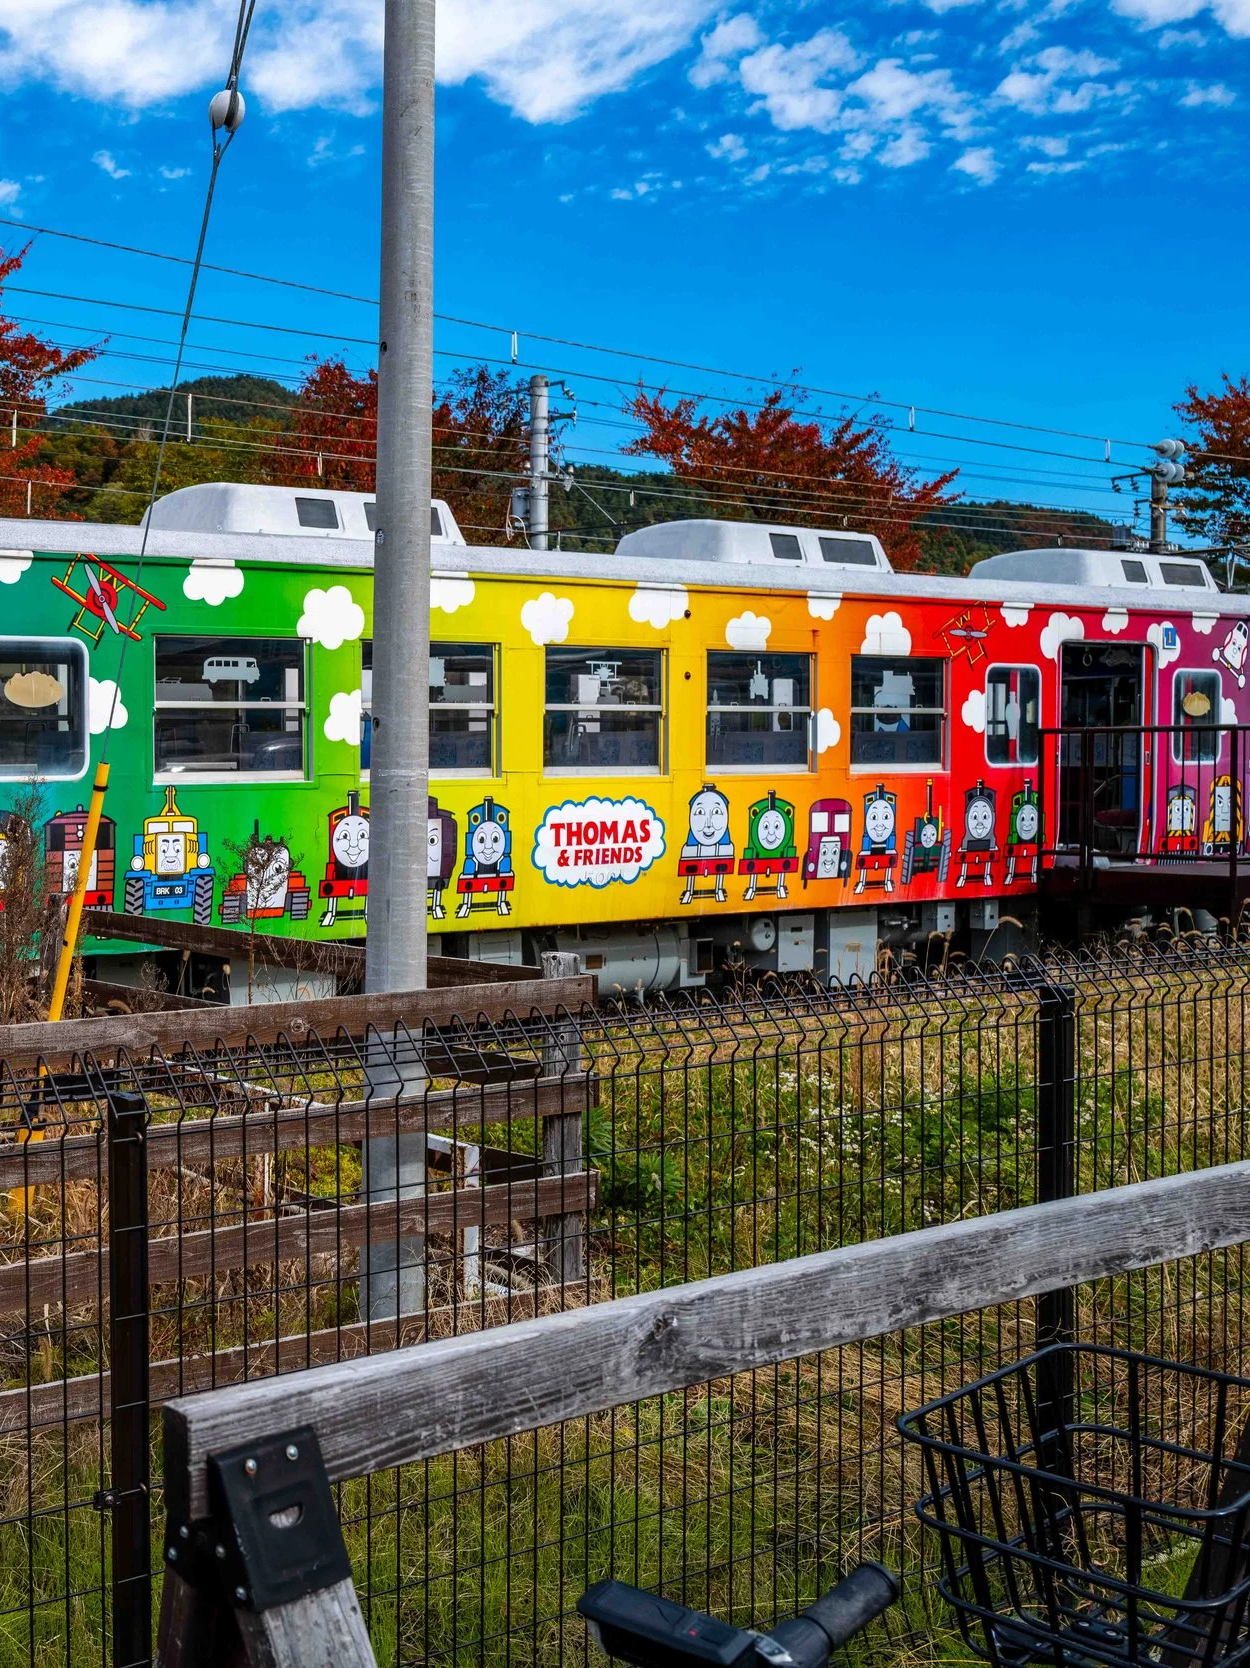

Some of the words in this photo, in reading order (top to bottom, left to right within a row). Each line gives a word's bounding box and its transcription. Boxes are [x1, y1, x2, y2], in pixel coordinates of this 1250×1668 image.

[550, 819, 651, 847] THOMAS
[557, 850, 570, 867] &
[574, 846, 643, 866] FRIENDS
[156, 887, 170, 895] BRK
[174, 886, 183, 894] 03
